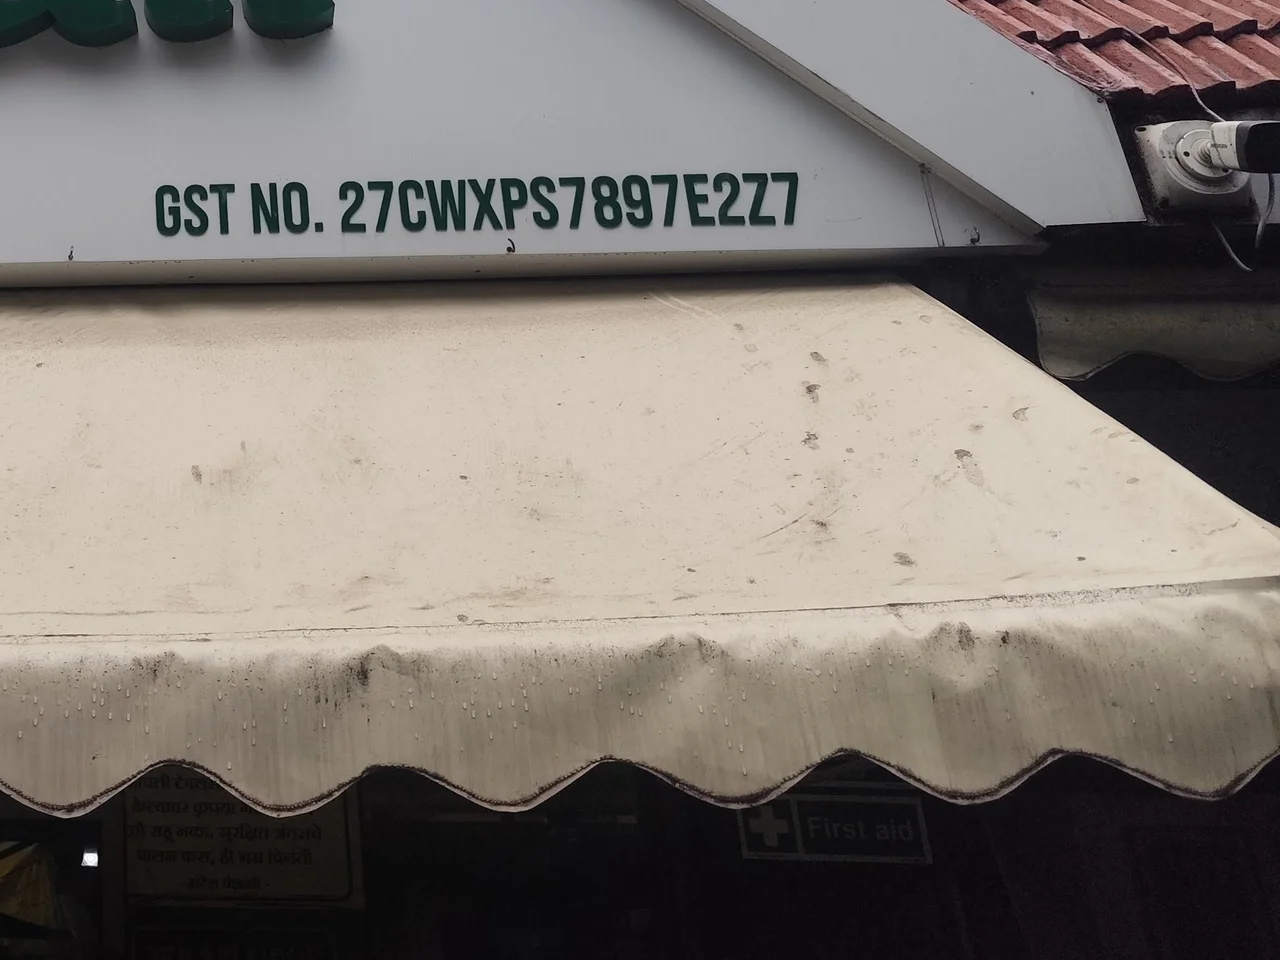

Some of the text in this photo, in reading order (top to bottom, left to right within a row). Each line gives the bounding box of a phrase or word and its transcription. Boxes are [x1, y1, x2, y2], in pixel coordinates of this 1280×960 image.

[156, 172, 799, 237] GST NO. 27CWXPS7897E2Z7
[807, 816, 914, 842] First aid
